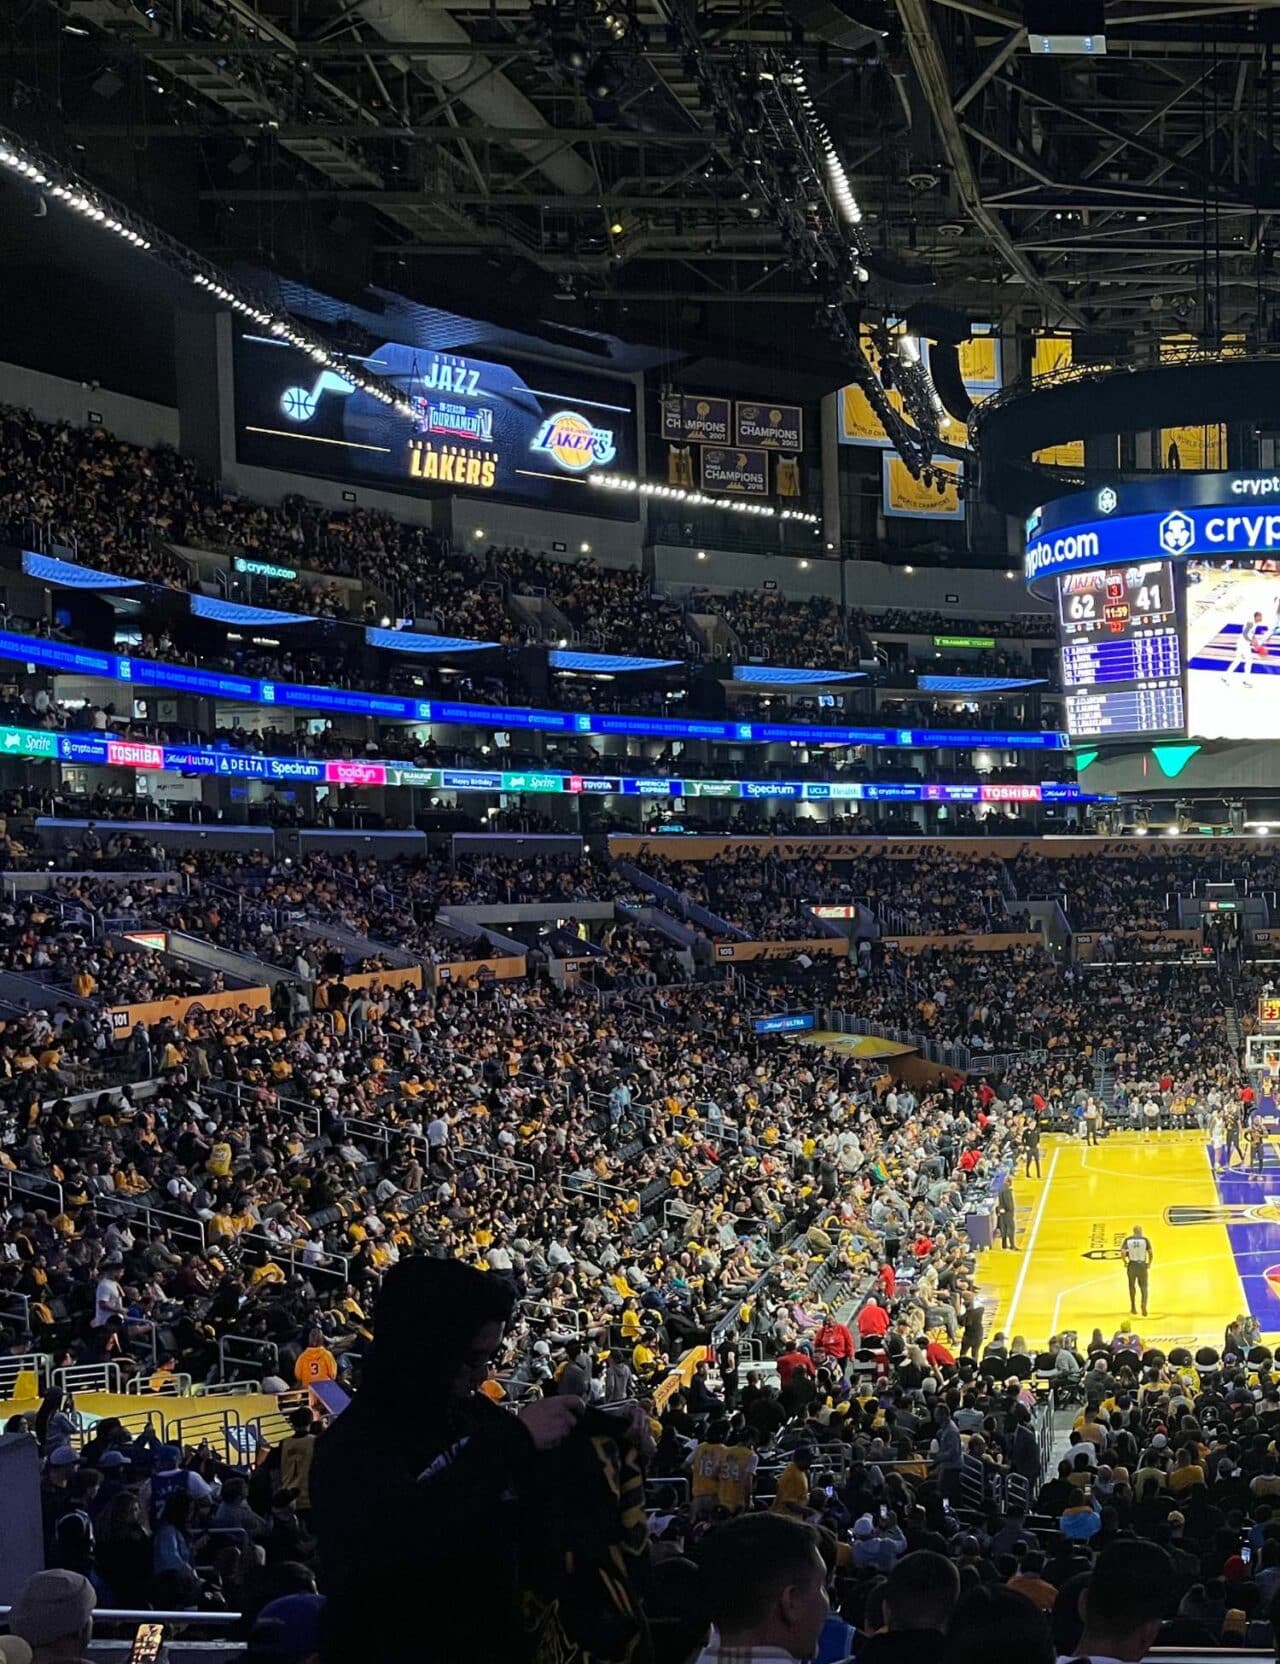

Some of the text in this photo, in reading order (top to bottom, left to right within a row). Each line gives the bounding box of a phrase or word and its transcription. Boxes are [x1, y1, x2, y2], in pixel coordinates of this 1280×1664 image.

[424, 363, 481, 398] JAZZ
[428, 406, 482, 441] TOURNAMENT
[740, 425, 798, 440] CHAMPIONS
[540, 424, 609, 455] LAKERS
[411, 449, 496, 488] LAKERS
[705, 469, 764, 484] CHAMPIONS
[247, 560, 296, 580] crypto.com
[1111, 586, 1119, 596] 3
[1136, 584, 1161, 610] 41
[1071, 594, 1096, 619] 62
[1105, 606, 1128, 619] 11:59
[26, 735, 51, 751] Sprite
[72, 743, 104, 755] crypto.com
[111, 746, 161, 763] TOSHIBA
[192, 756, 214, 766] ULTRA
[231, 759, 263, 773] DELTA
[272, 761, 318, 776] Spectrum
[337, 766, 376, 781] boldyn
[471, 778, 493, 786] Birthday
[529, 777, 555, 789] Sprite
[583, 782, 612, 790] TOYOTA
[747, 784, 794, 796] Spectrum
[833, 787, 859, 795] Health
[879, 788, 916, 796] crypto.com
[986, 789, 1037, 798] TOSHIBA
[723, 844, 947, 856] LOS ANGELES LAKERS
[1101, 843, 1140, 853] LOS
[1149, 843, 1233, 853] ANGELES
[115, 1013, 128, 1026] 101
[1263, 1008, 1279, 1018] 23
[786, 1019, 804, 1027] ULTRA
[310, 1363, 319, 1375] 3
[720, 1461, 739, 1480] 34
